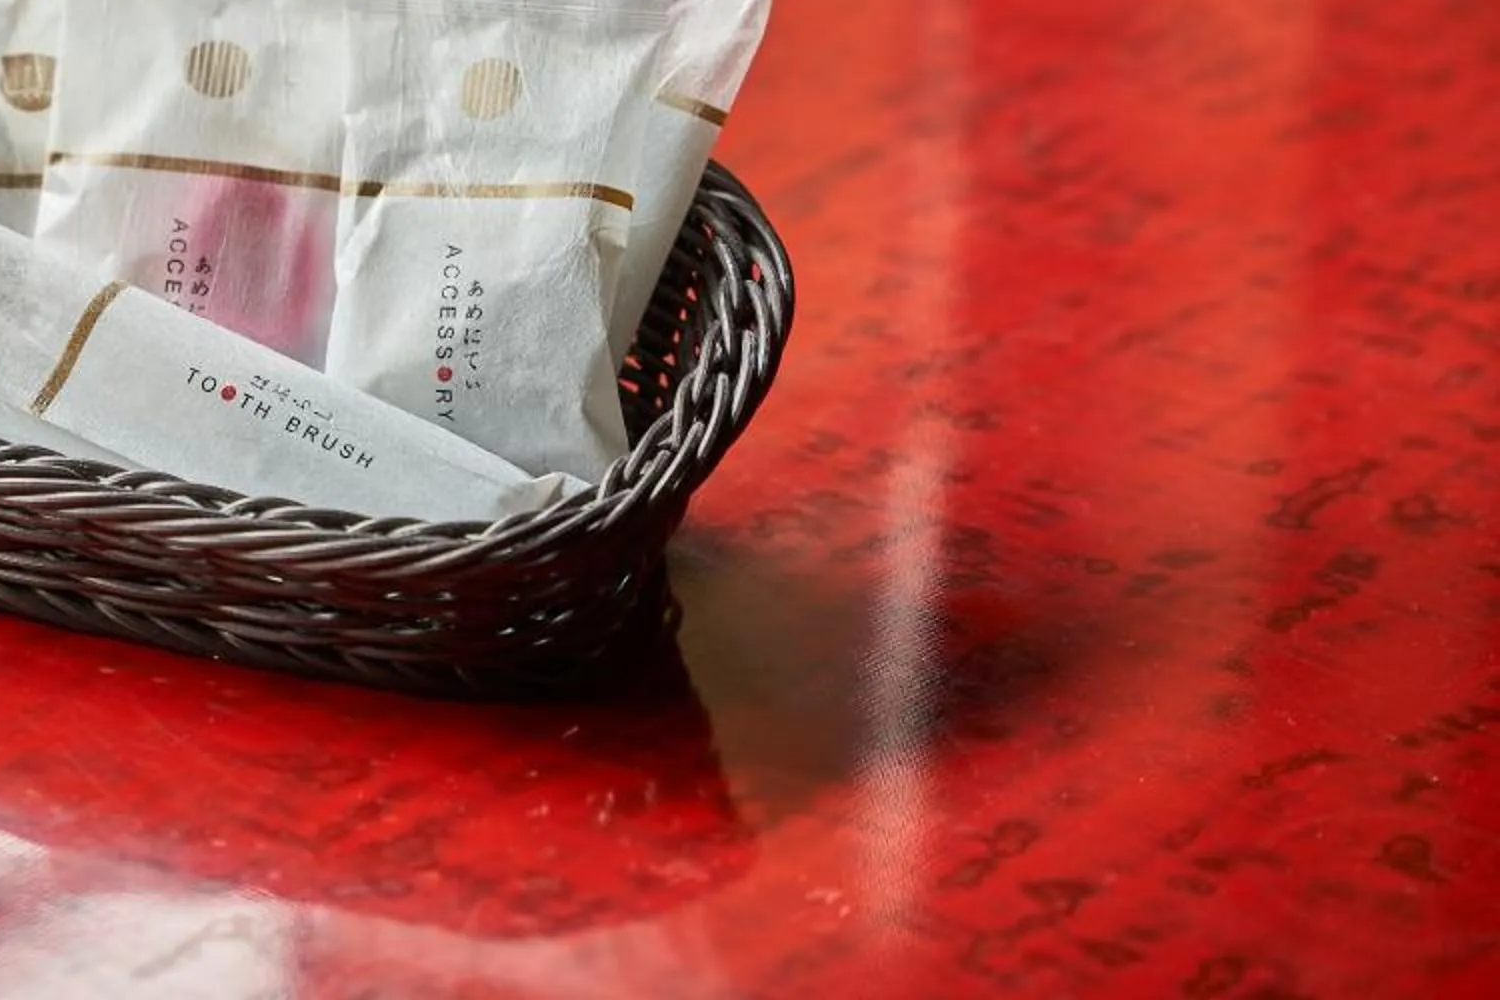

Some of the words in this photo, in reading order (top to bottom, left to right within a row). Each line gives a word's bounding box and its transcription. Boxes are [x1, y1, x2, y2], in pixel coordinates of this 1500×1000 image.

[164, 218, 190, 307] ACCE
[186, 367, 273, 420] TOOTH
[284, 415, 375, 469] BRUSH
